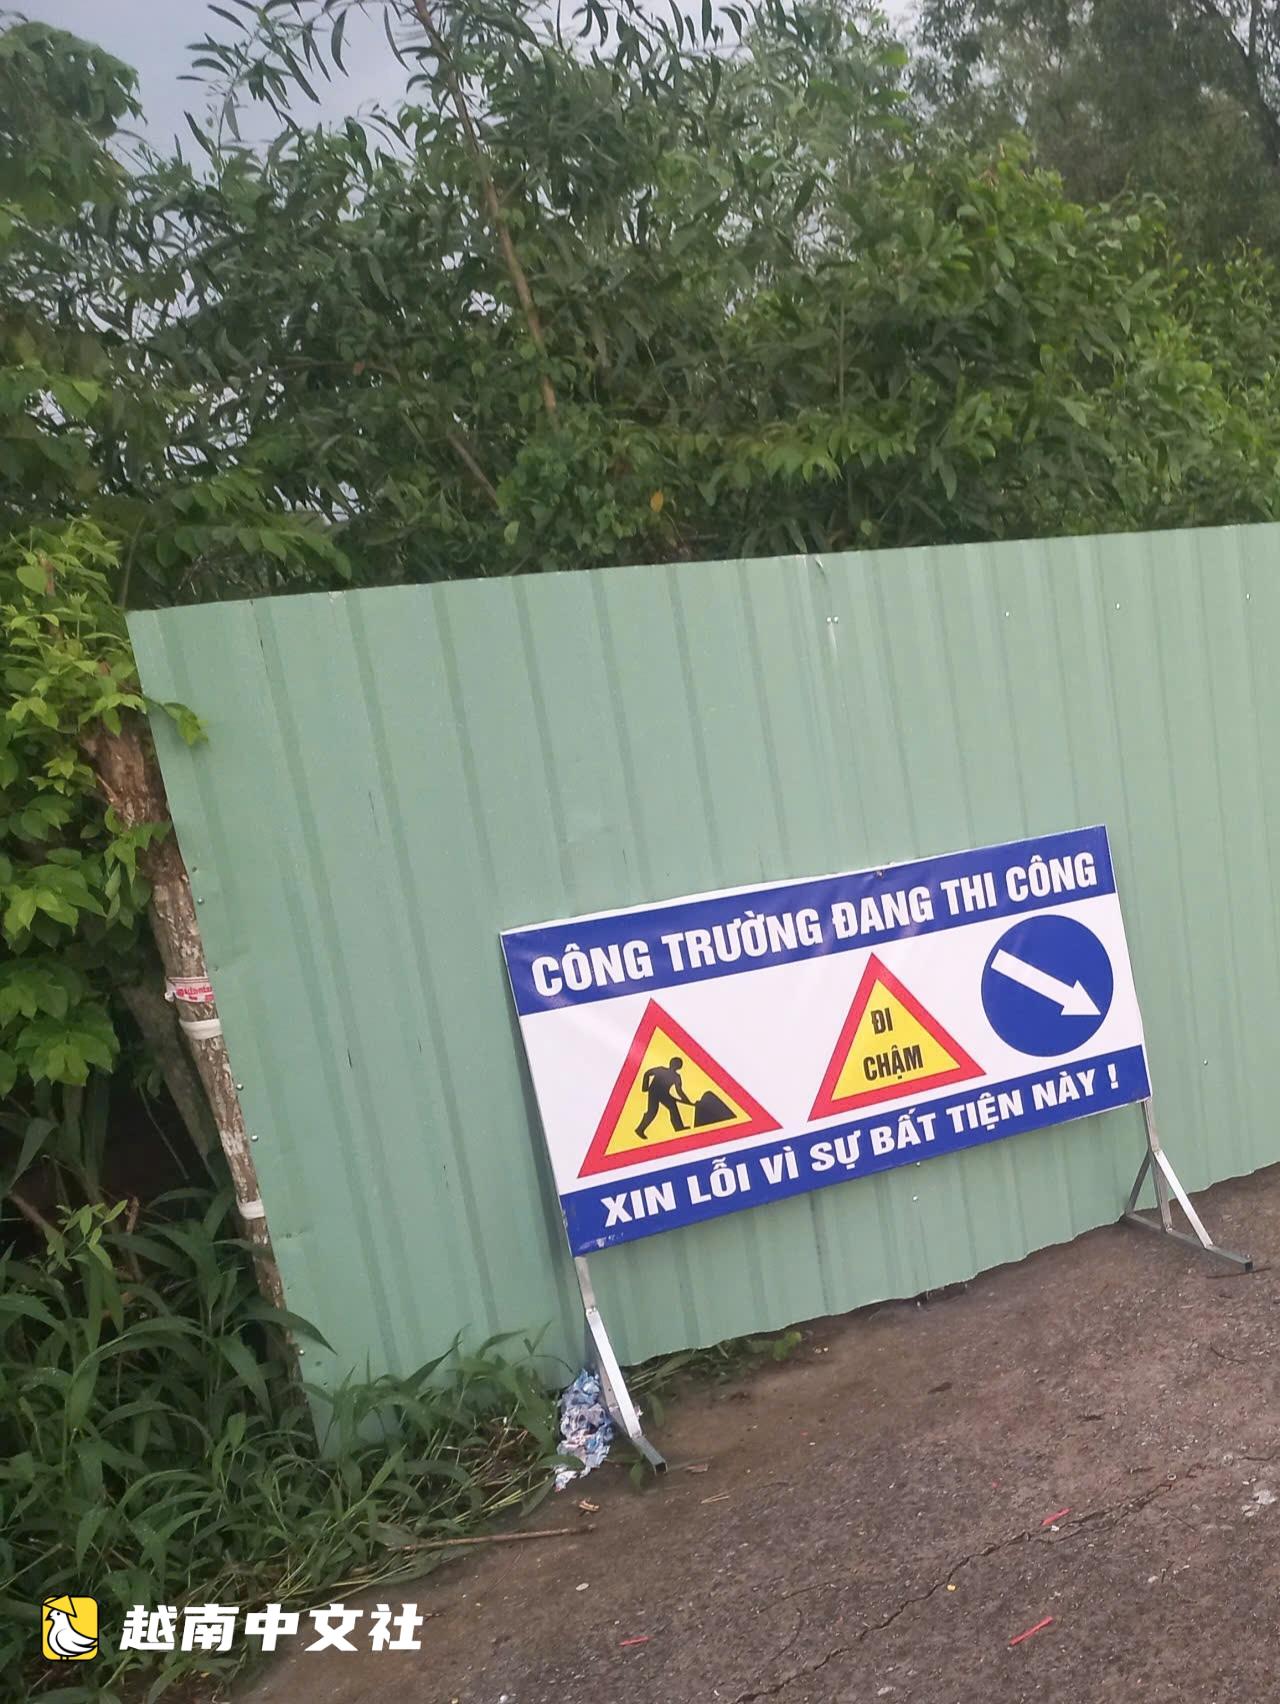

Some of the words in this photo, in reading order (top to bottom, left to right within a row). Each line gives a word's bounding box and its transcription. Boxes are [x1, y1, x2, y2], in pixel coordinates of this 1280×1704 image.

[531, 943, 654, 997] CÔNG
[661, 909, 823, 972] TRƯỜNG
[831, 886, 934, 939] ĐANG
[940, 872, 997, 915] THI
[1005, 852, 1097, 902] CÔNG
[863, 1044, 923, 1081] CHẬM
[870, 1007, 893, 1034] ĐI
[601, 1182, 677, 1227] XIN
[687, 1157, 751, 1204] LỖI
[760, 1146, 799, 1185] VÌ
[809, 1130, 861, 1172] SỰ
[870, 1107, 936, 1156] BẤT
[946, 1091, 1024, 1131] TIỆN
[1031, 1070, 1096, 1110] NÀY
